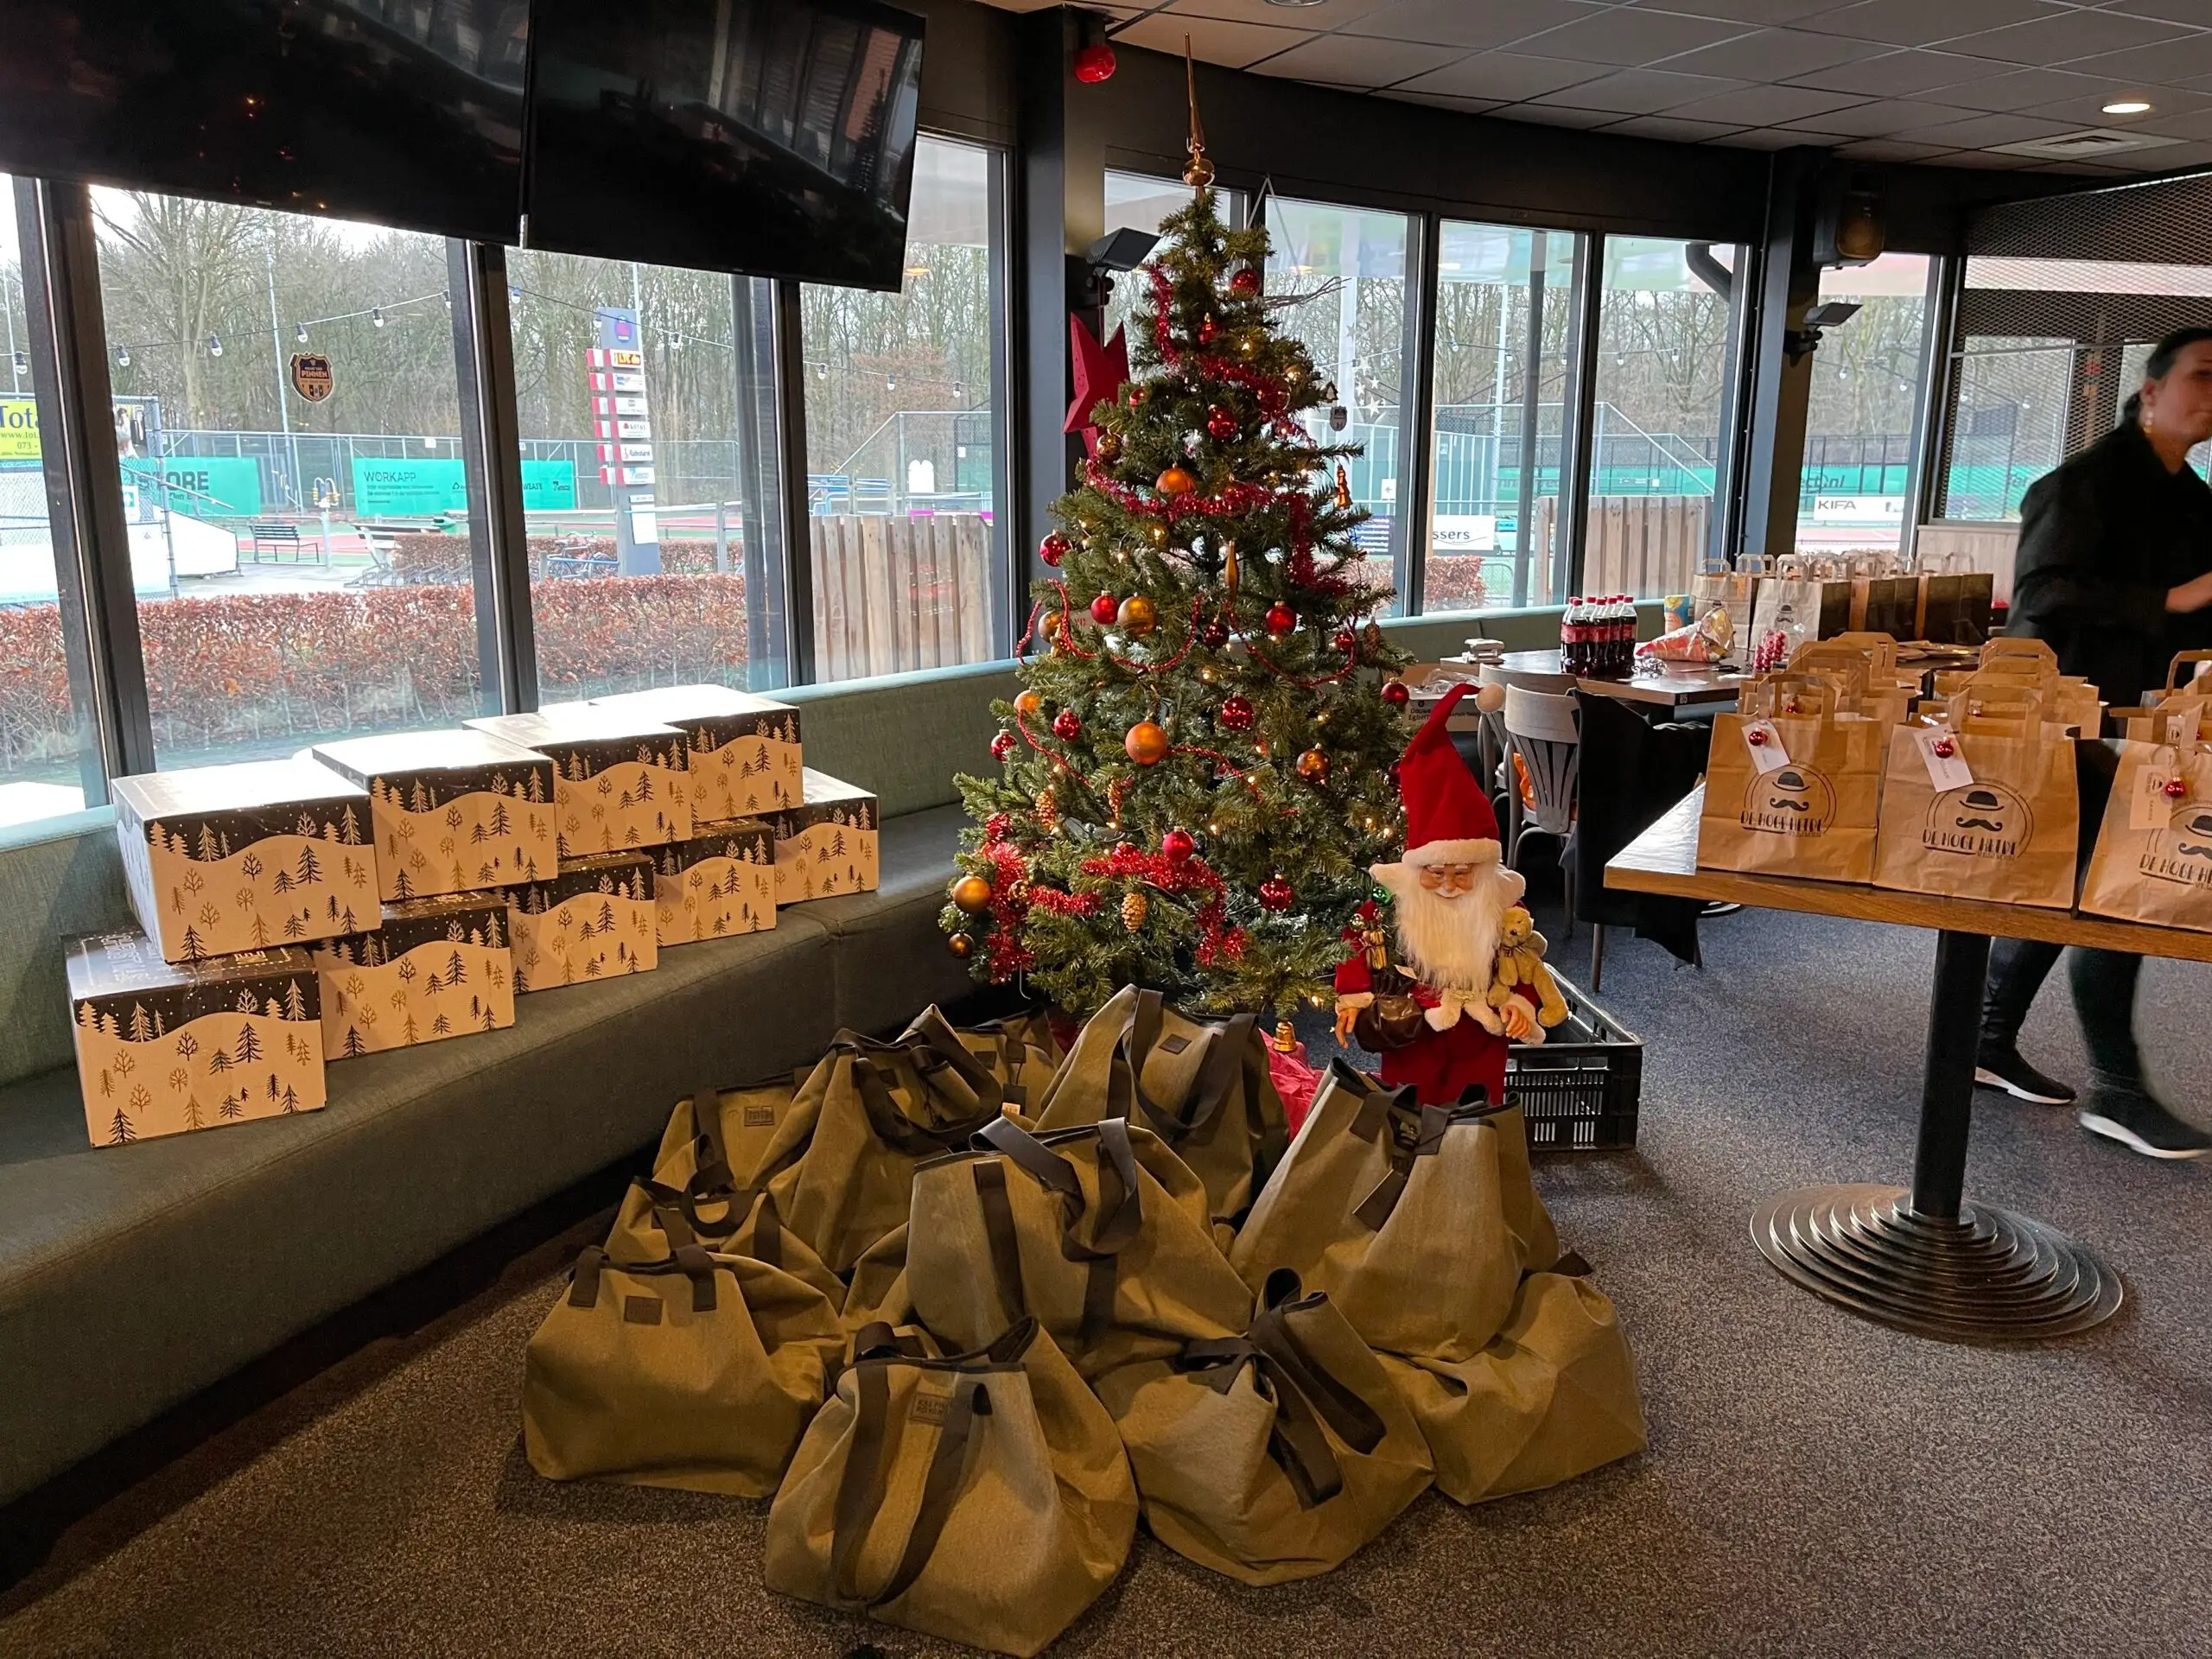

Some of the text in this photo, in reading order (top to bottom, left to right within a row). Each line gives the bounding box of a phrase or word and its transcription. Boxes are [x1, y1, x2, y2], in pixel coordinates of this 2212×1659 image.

[364, 472, 416, 482] WORKAPP
[1818, 500, 1857, 510] KIFA
[1740, 810, 1753, 825] DE
[1758, 813, 1786, 830] HOGE
[1923, 829, 1937, 845] DE
[1942, 832, 1974, 850] HOGE
[2139, 854, 2157, 870] DE
[2159, 858, 2196, 880] HOGE
